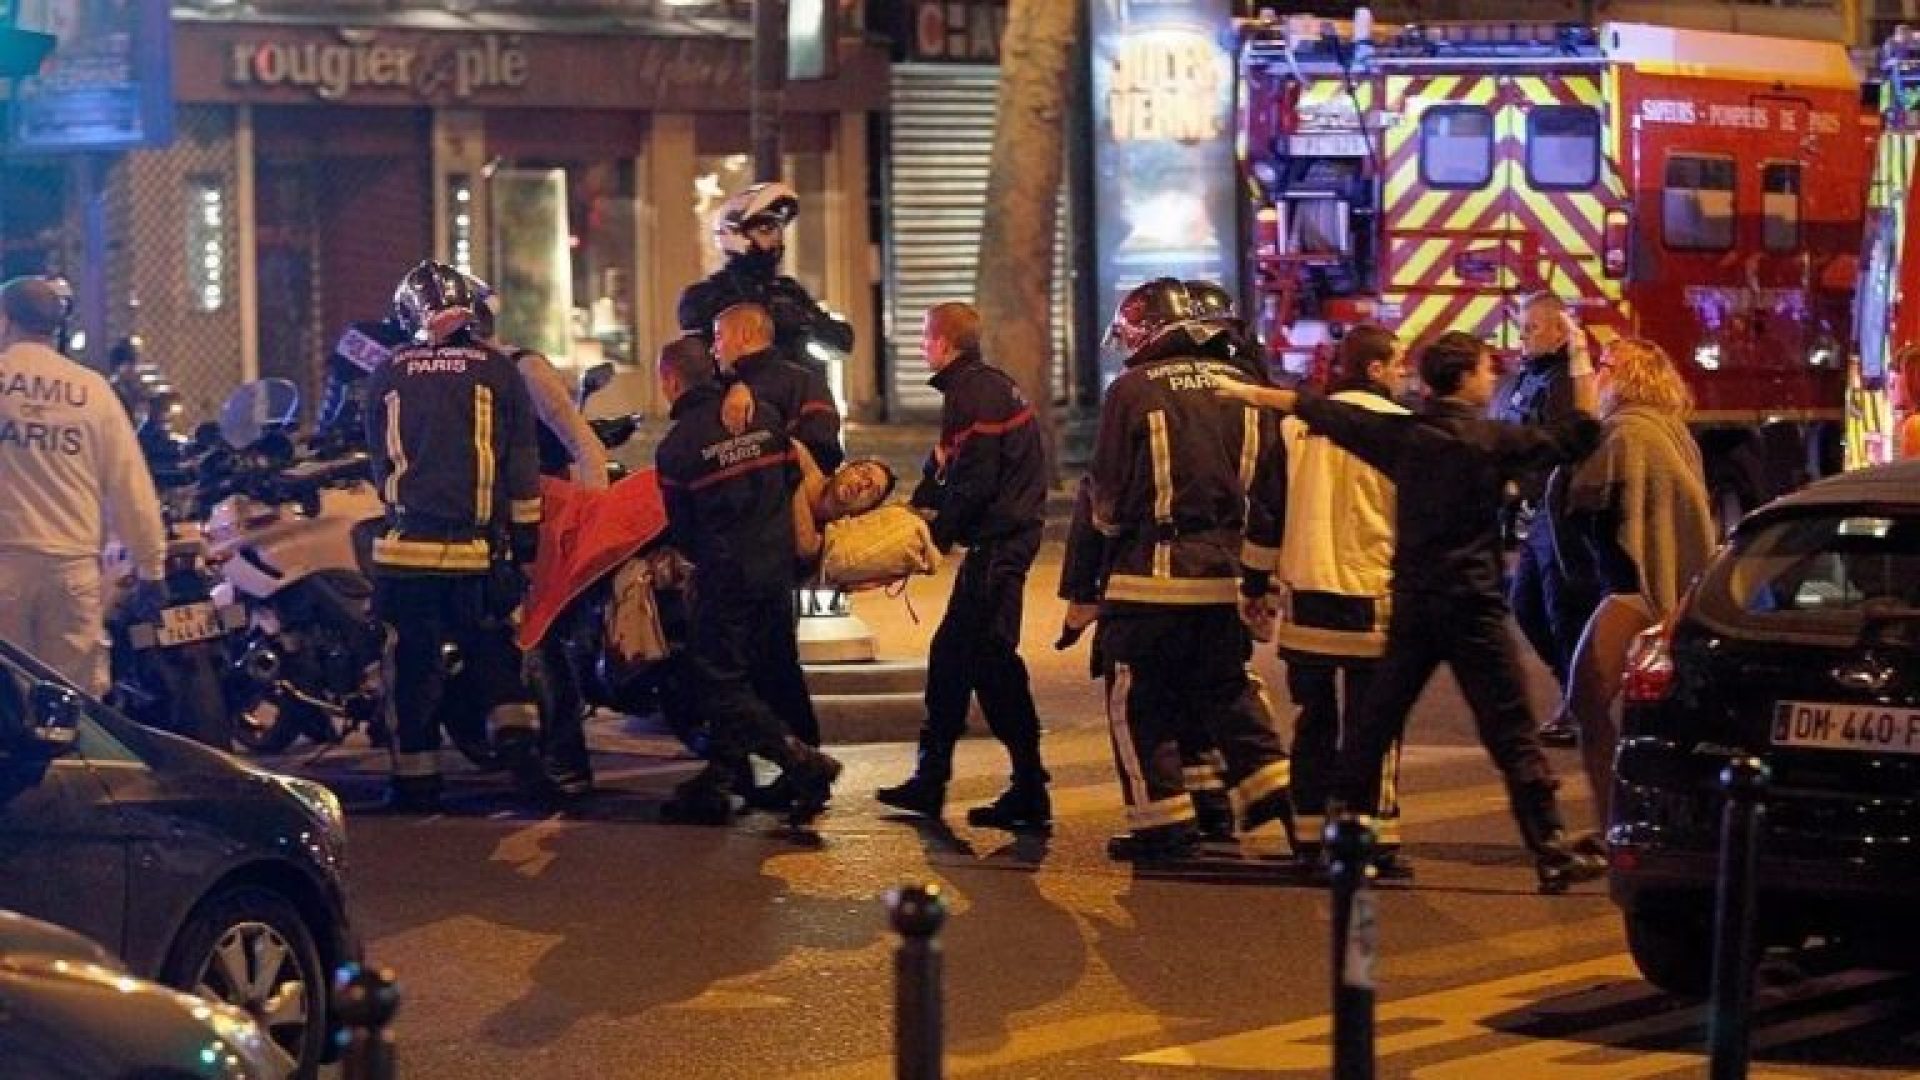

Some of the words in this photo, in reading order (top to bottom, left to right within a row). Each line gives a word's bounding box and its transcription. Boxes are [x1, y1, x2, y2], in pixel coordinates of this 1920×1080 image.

[234, 42, 416, 98] rougier
[456, 35, 528, 97] plé
[407, 359, 466, 377] PARIS
[719, 444, 761, 468] PARIS
